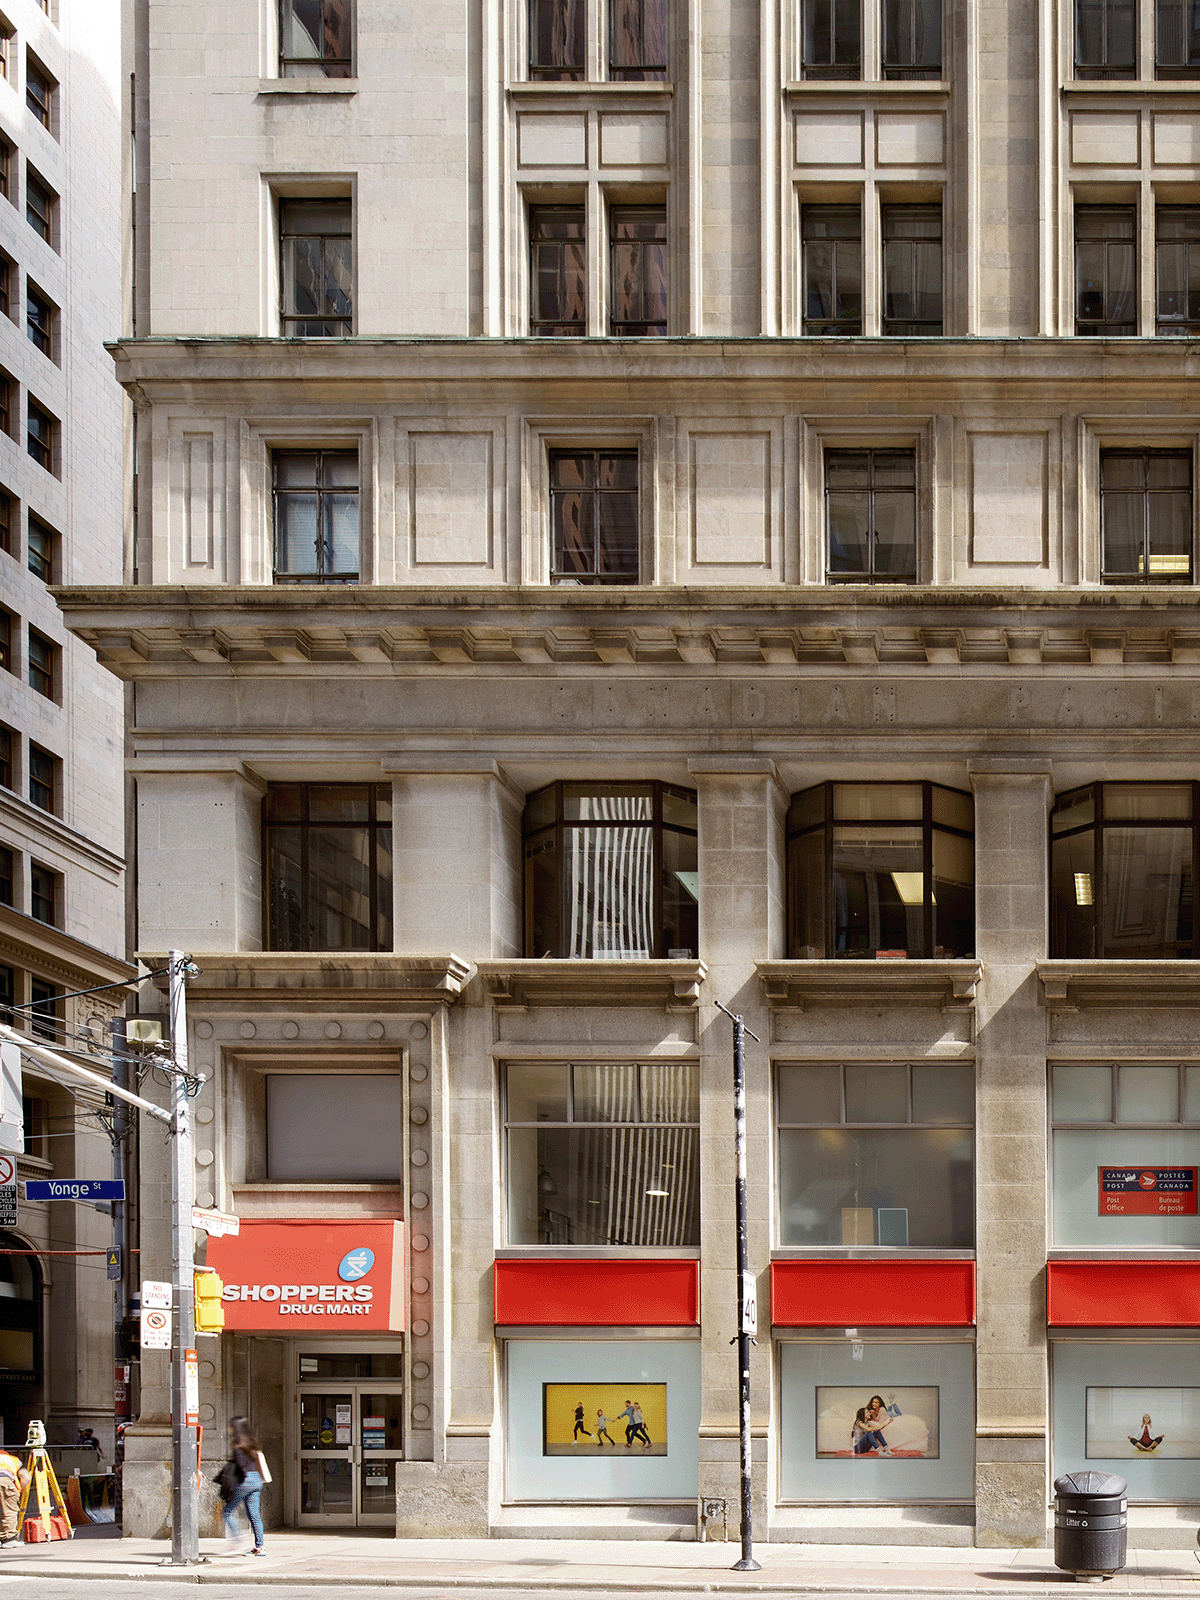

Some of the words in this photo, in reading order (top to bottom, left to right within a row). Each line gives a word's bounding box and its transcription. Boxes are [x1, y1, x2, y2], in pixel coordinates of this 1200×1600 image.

[48, 1181, 89, 1198] Yonge
[93, 1182, 101, 1190] St
[152, 1284, 163, 1292] NO
[222, 1284, 373, 1302] SHOPPERS
[145, 1291, 170, 1301] STANDING
[279, 1304, 325, 1315] DRUG
[326, 1304, 372, 1315] MART
[745, 1298, 755, 1325] 40
[1066, 1518, 1080, 1526] Litter
